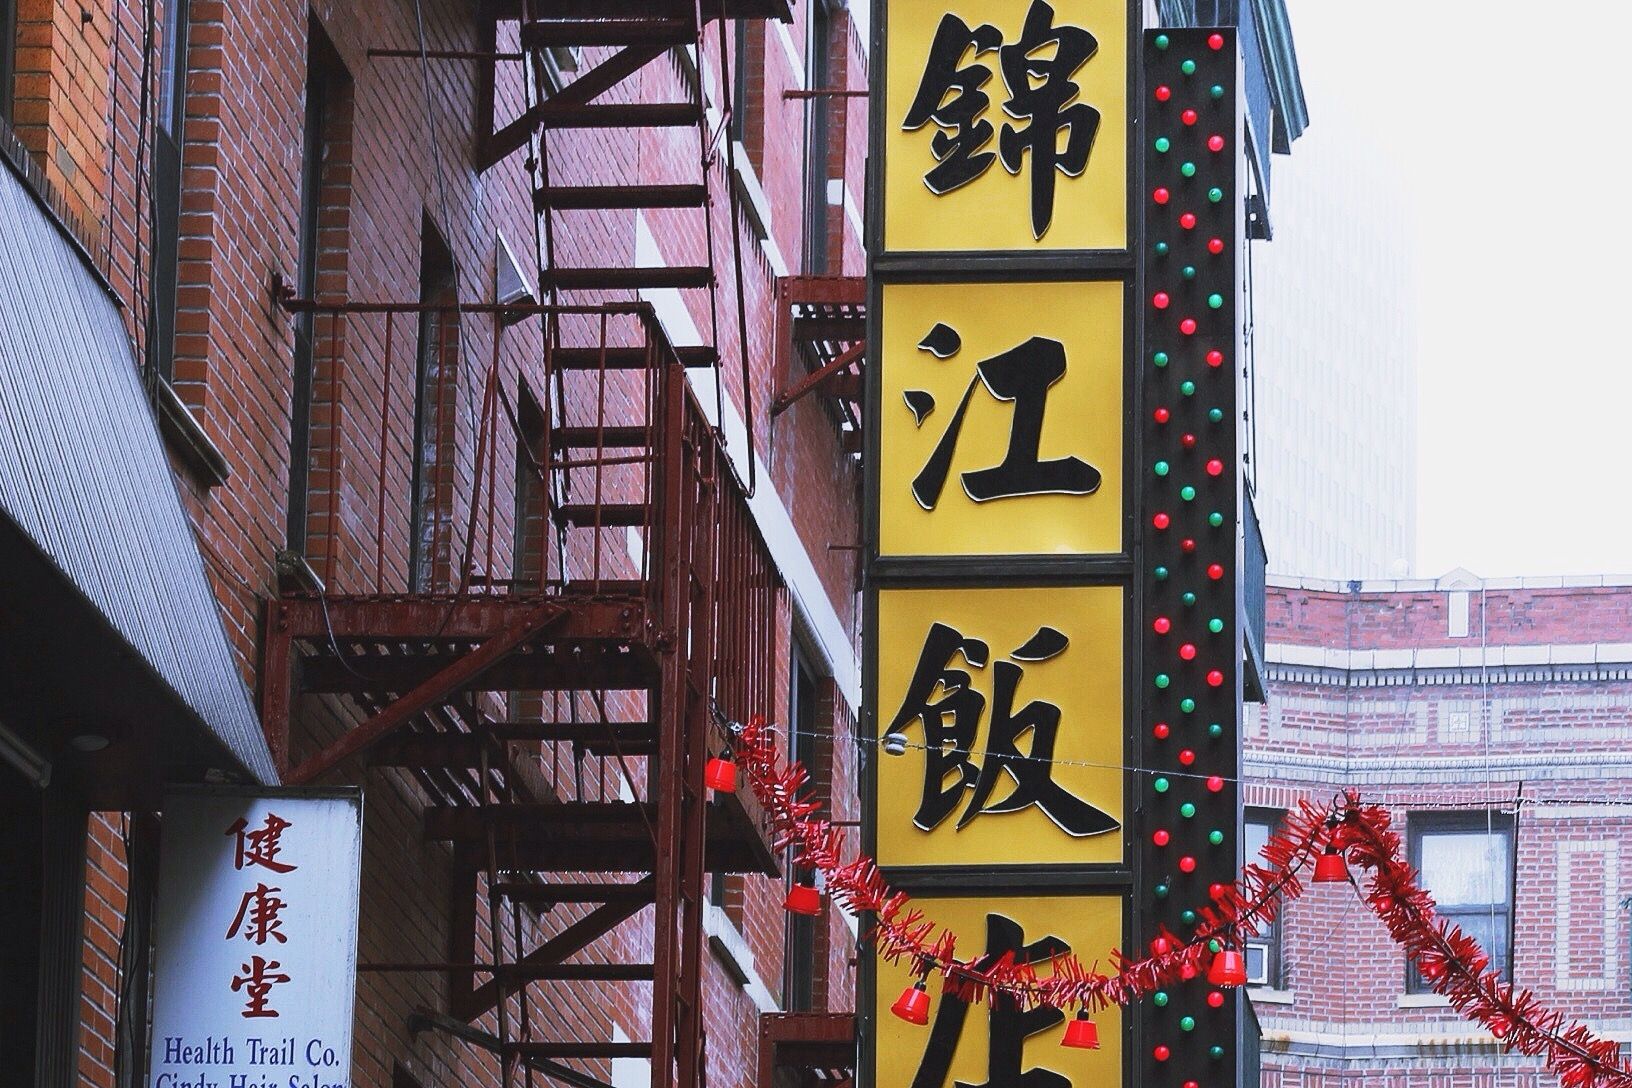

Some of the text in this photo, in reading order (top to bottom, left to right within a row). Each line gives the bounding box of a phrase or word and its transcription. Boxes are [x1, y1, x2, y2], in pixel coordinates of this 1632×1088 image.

[225, 811, 298, 1018] 健康堂
[163, 1036, 340, 1067] Health Trail Co.
